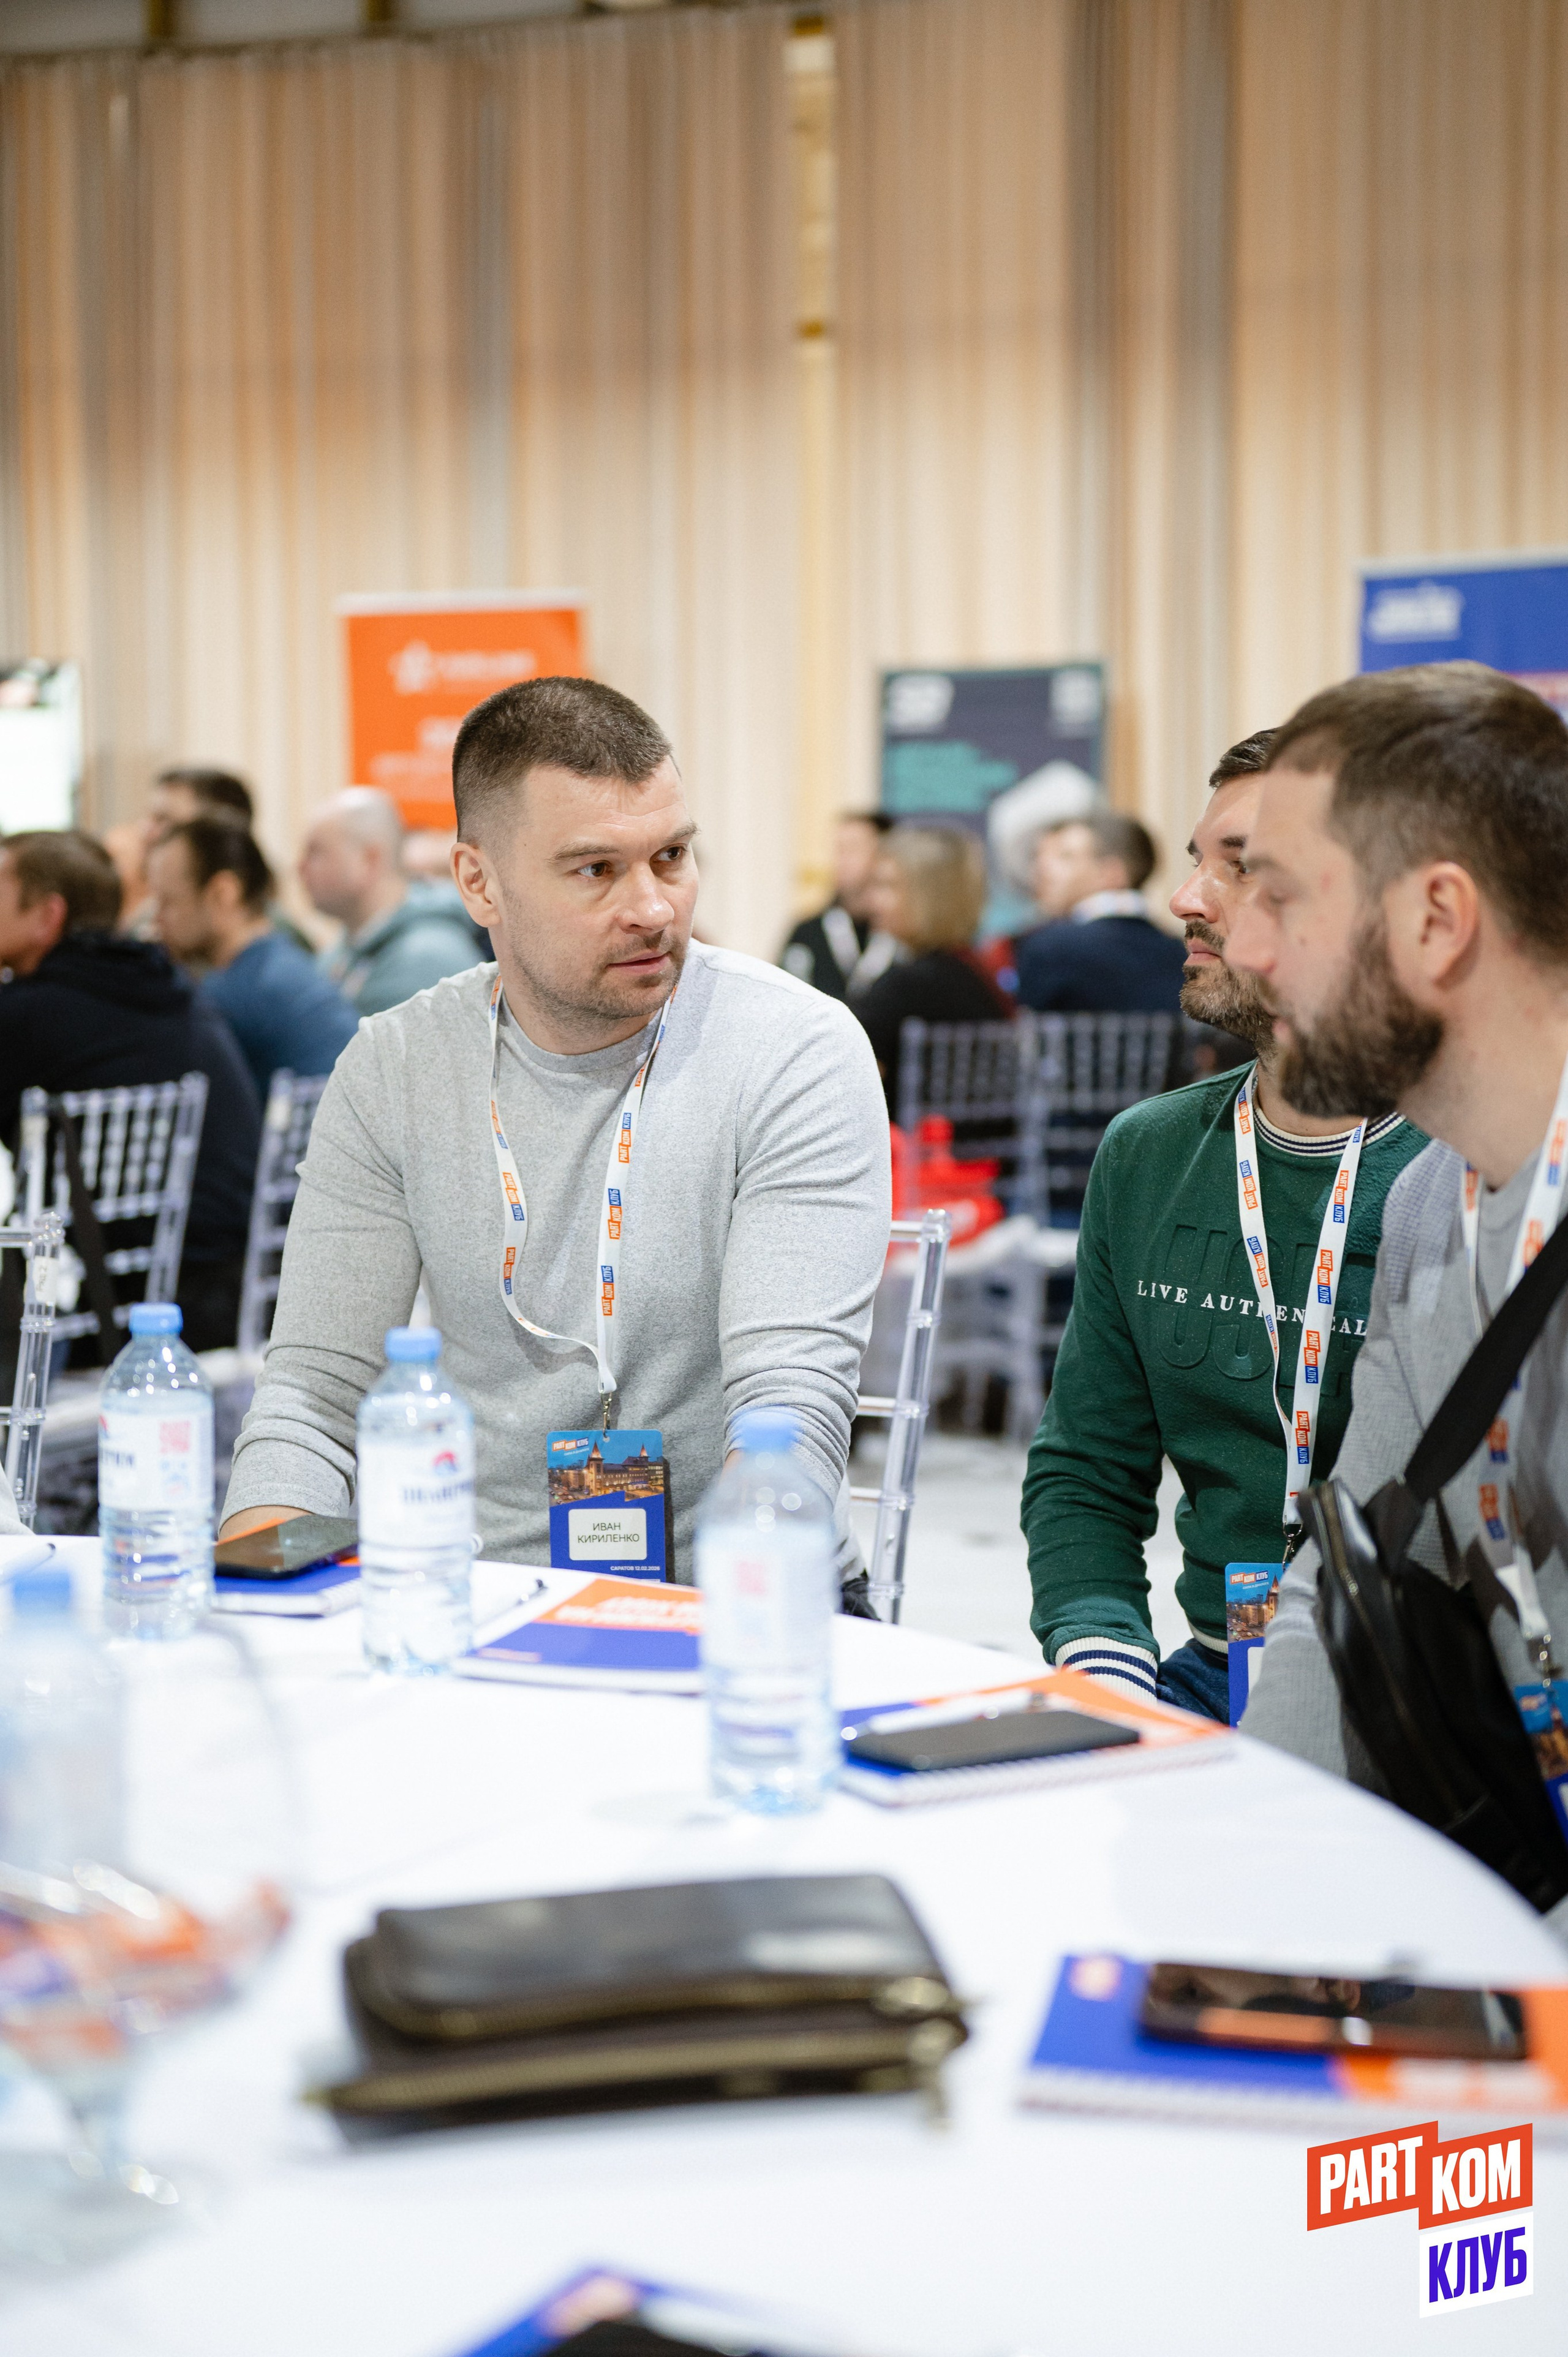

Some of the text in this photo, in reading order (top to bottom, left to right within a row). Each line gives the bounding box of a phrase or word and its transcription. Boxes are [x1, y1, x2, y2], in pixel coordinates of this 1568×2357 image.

[1240, 1161, 1251, 1177] КЛУБ
[1340, 1171, 1348, 1189] PART
[609, 1189, 620, 1205] КЛУБ
[1246, 1191, 1257, 1209] PART
[1334, 1205, 1344, 1223] КЛУБ
[1248, 1237, 1262, 1254] КЛУБ
[603, 1266, 612, 1282] КЛУБ
[1318, 1251, 1332, 1304] PART KOM КЛУБ
[1137, 1280, 1188, 1304] LIVE
[1305, 1332, 1319, 1383] PART KOM КЛУБ
[1297, 1412, 1309, 1463] PART KOM КЛУБ
[593, 1522, 620, 1531] ИВАН
[578, 1533, 639, 1543] КИРИЛЕНКО
